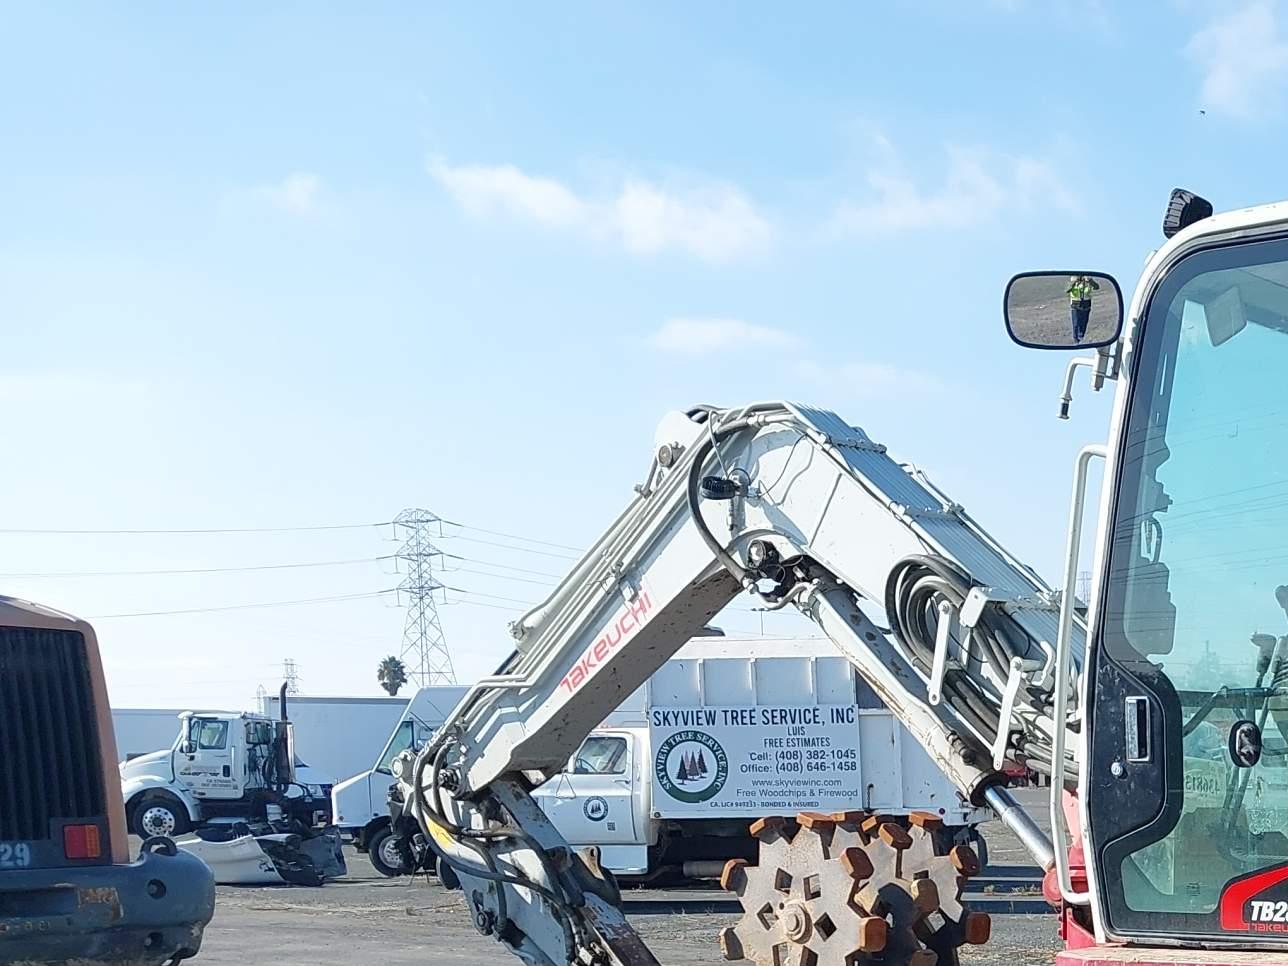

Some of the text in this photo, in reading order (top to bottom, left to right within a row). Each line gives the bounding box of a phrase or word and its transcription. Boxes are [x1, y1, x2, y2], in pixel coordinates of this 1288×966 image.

[560, 592, 652, 693] TAKEUCHI
[653, 706, 855, 727] SKYVIEW TREE SERVICE, INC
[787, 726, 806, 736] LUIS
[763, 737, 831, 748] FREE ESTIMATES
[657, 743, 672, 790] SKYVIEW
[668, 731, 696, 746] TREE
[749, 748, 857, 763] Cell: (408) 382-1045
[740, 760, 857, 774] Office: (408) 646-1458
[751, 778, 842, 788] www.skyviewinc.com
[736, 788, 858, 798] Free Woodchips & Firewood
